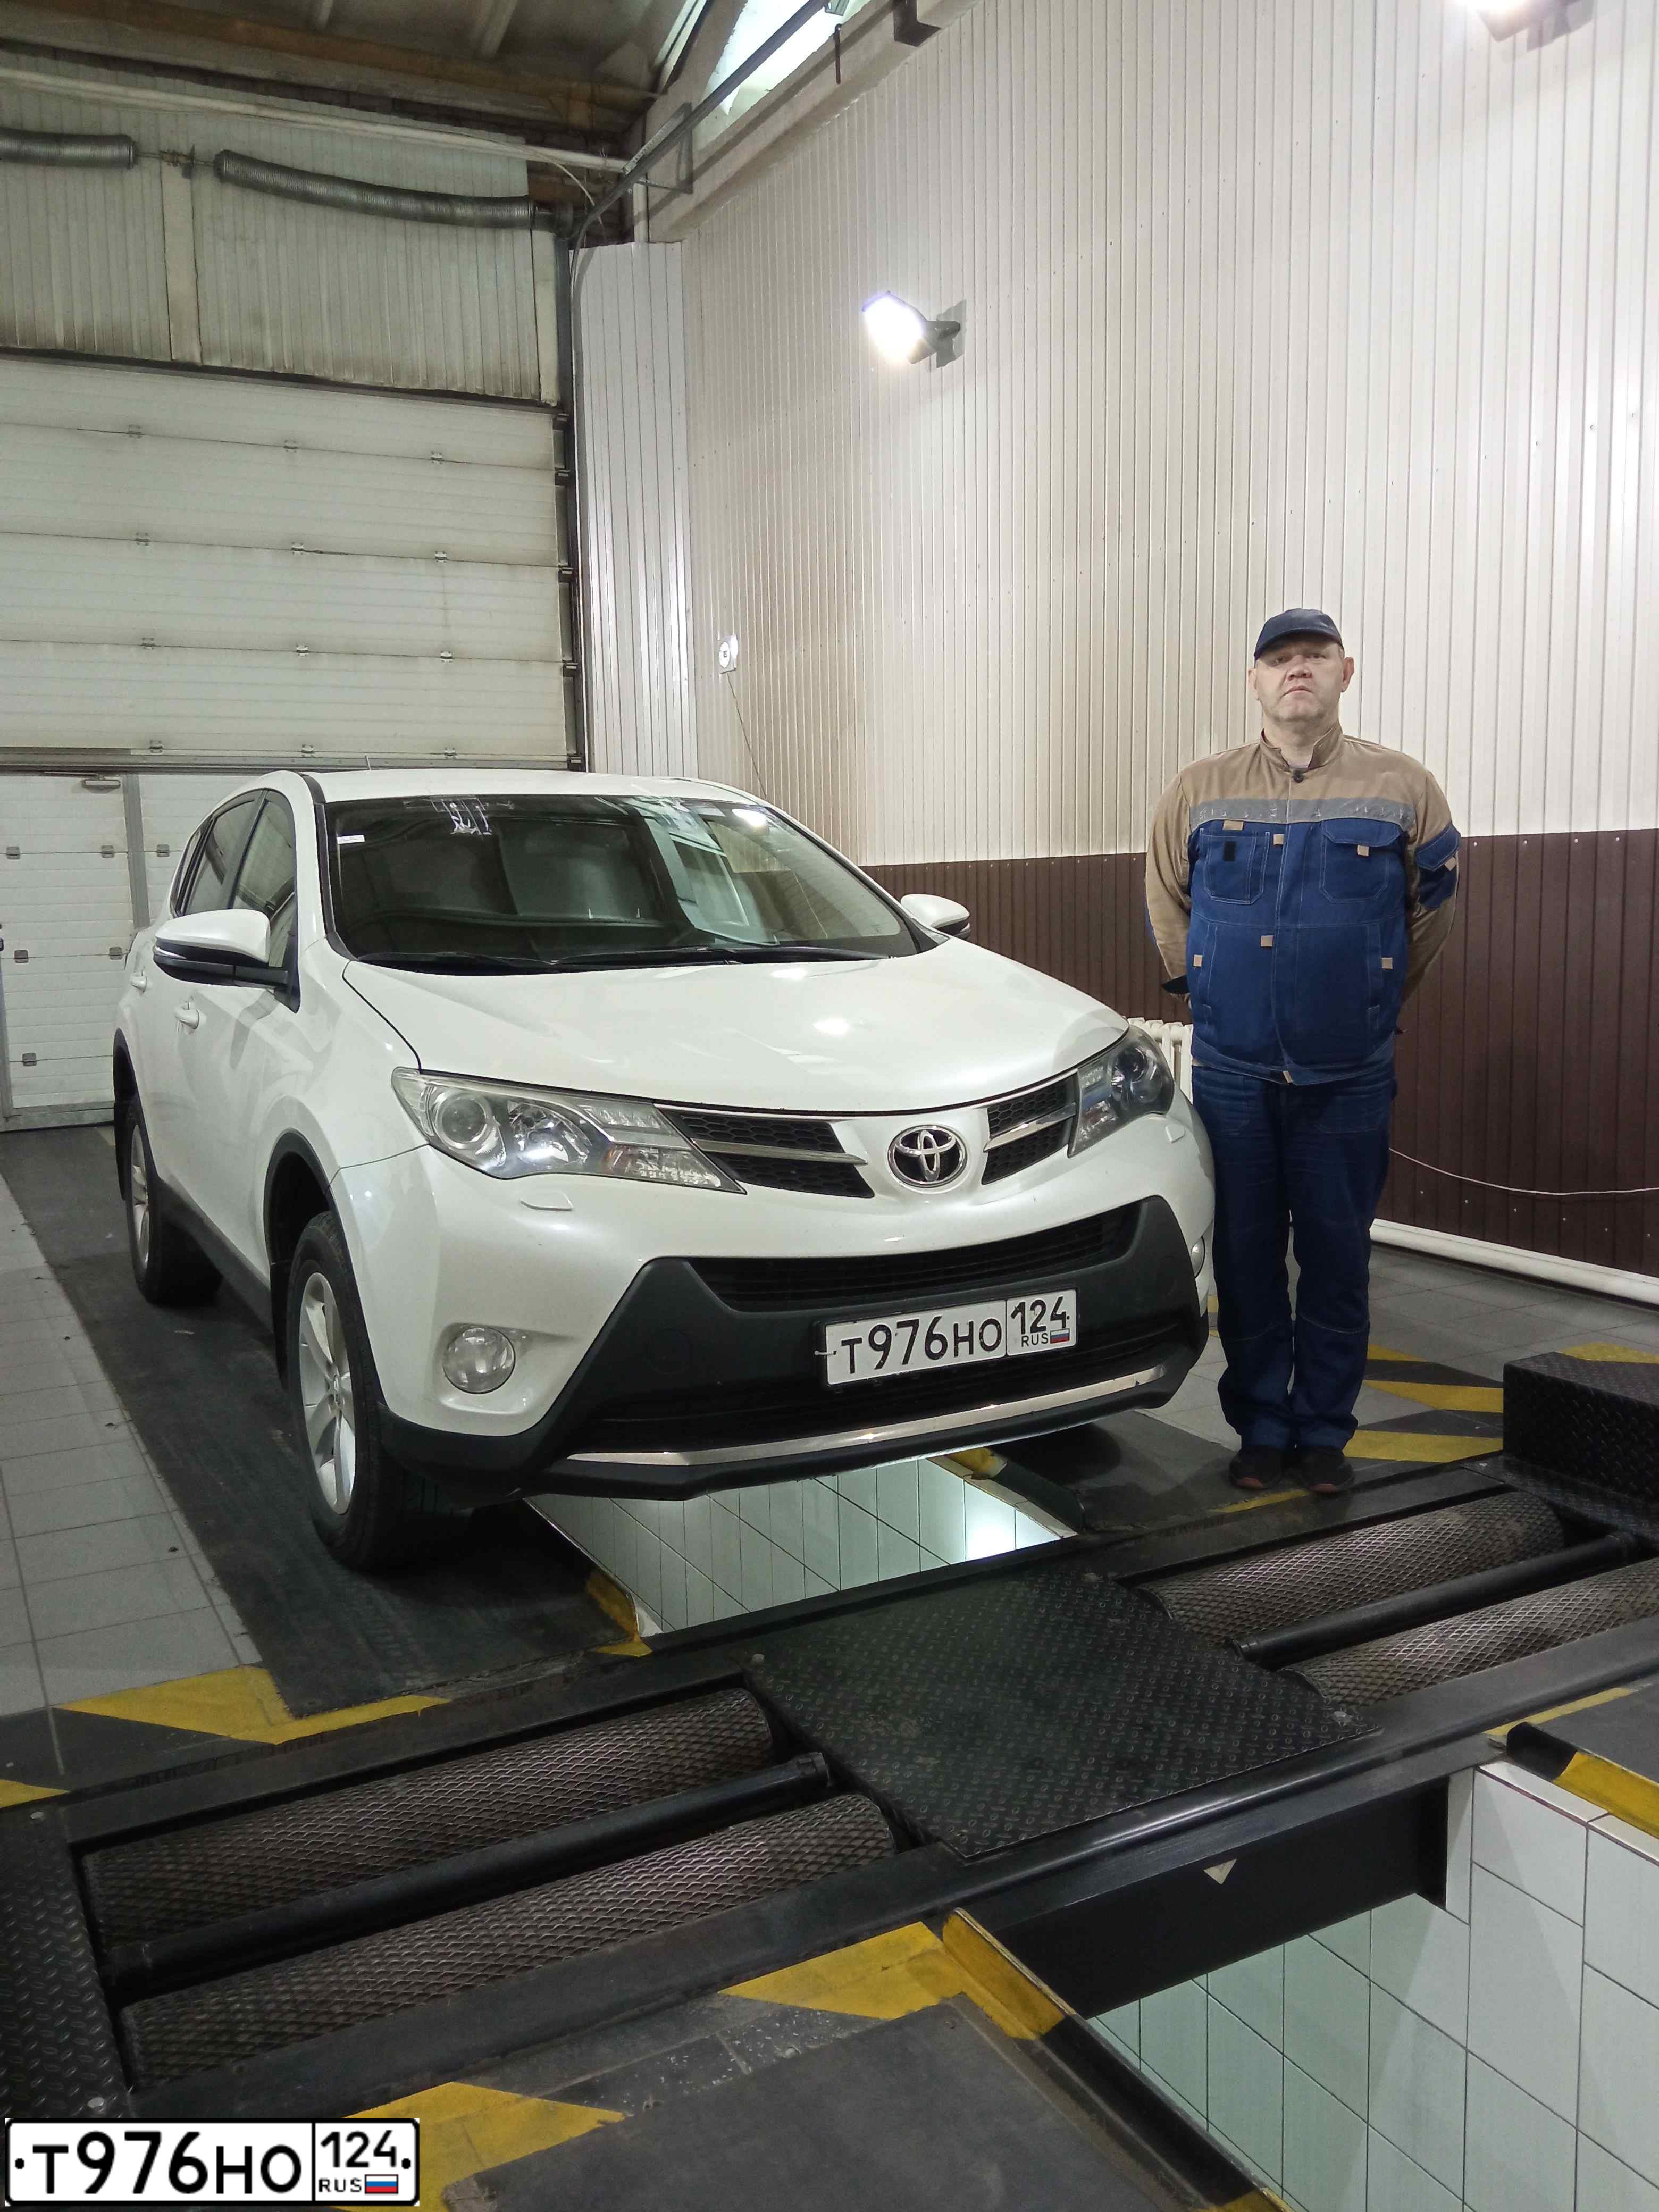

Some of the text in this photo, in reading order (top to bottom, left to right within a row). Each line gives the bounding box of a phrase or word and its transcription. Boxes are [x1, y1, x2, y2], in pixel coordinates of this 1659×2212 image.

[841, 1296, 1067, 1374] Т976НО 124
[1020, 1334, 1049, 1348] RUS
